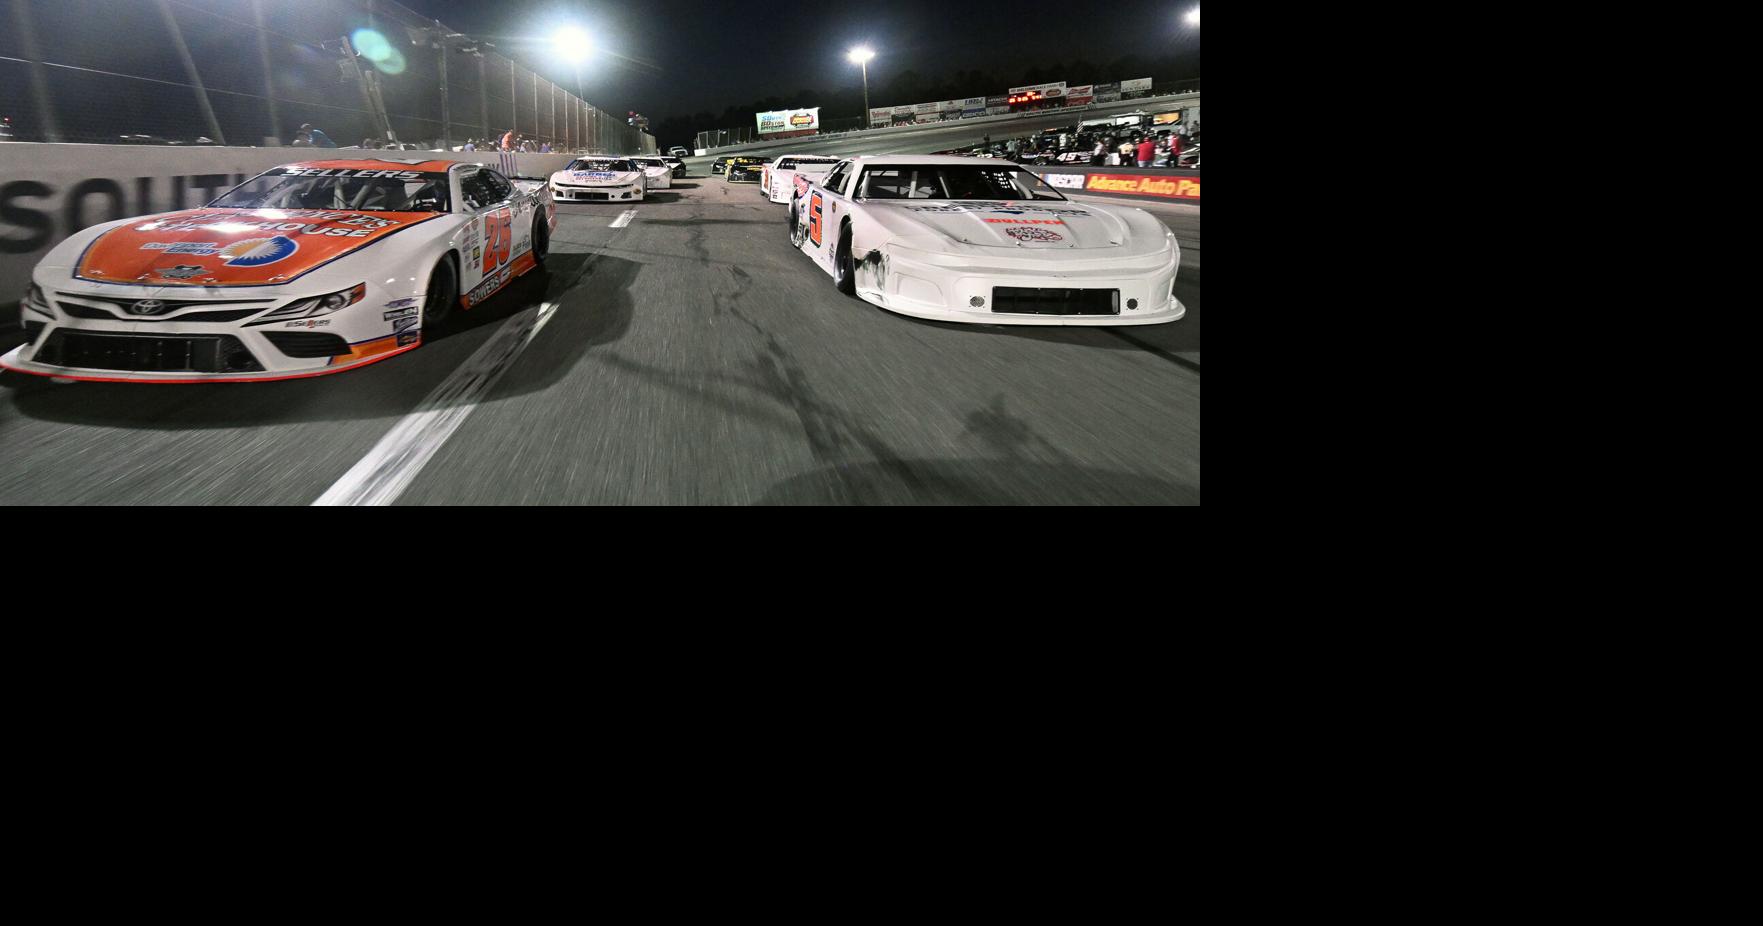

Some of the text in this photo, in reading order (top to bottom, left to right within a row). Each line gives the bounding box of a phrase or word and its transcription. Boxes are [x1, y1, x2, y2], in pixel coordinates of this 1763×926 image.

[282, 168, 424, 181] SELLERS
[1087, 174, 1137, 191] Advance
[1136, 177, 1176, 195] Auto
[810, 190, 823, 249] 5
[482, 207, 511, 278] 26
[468, 276, 500, 305] SOWERS
